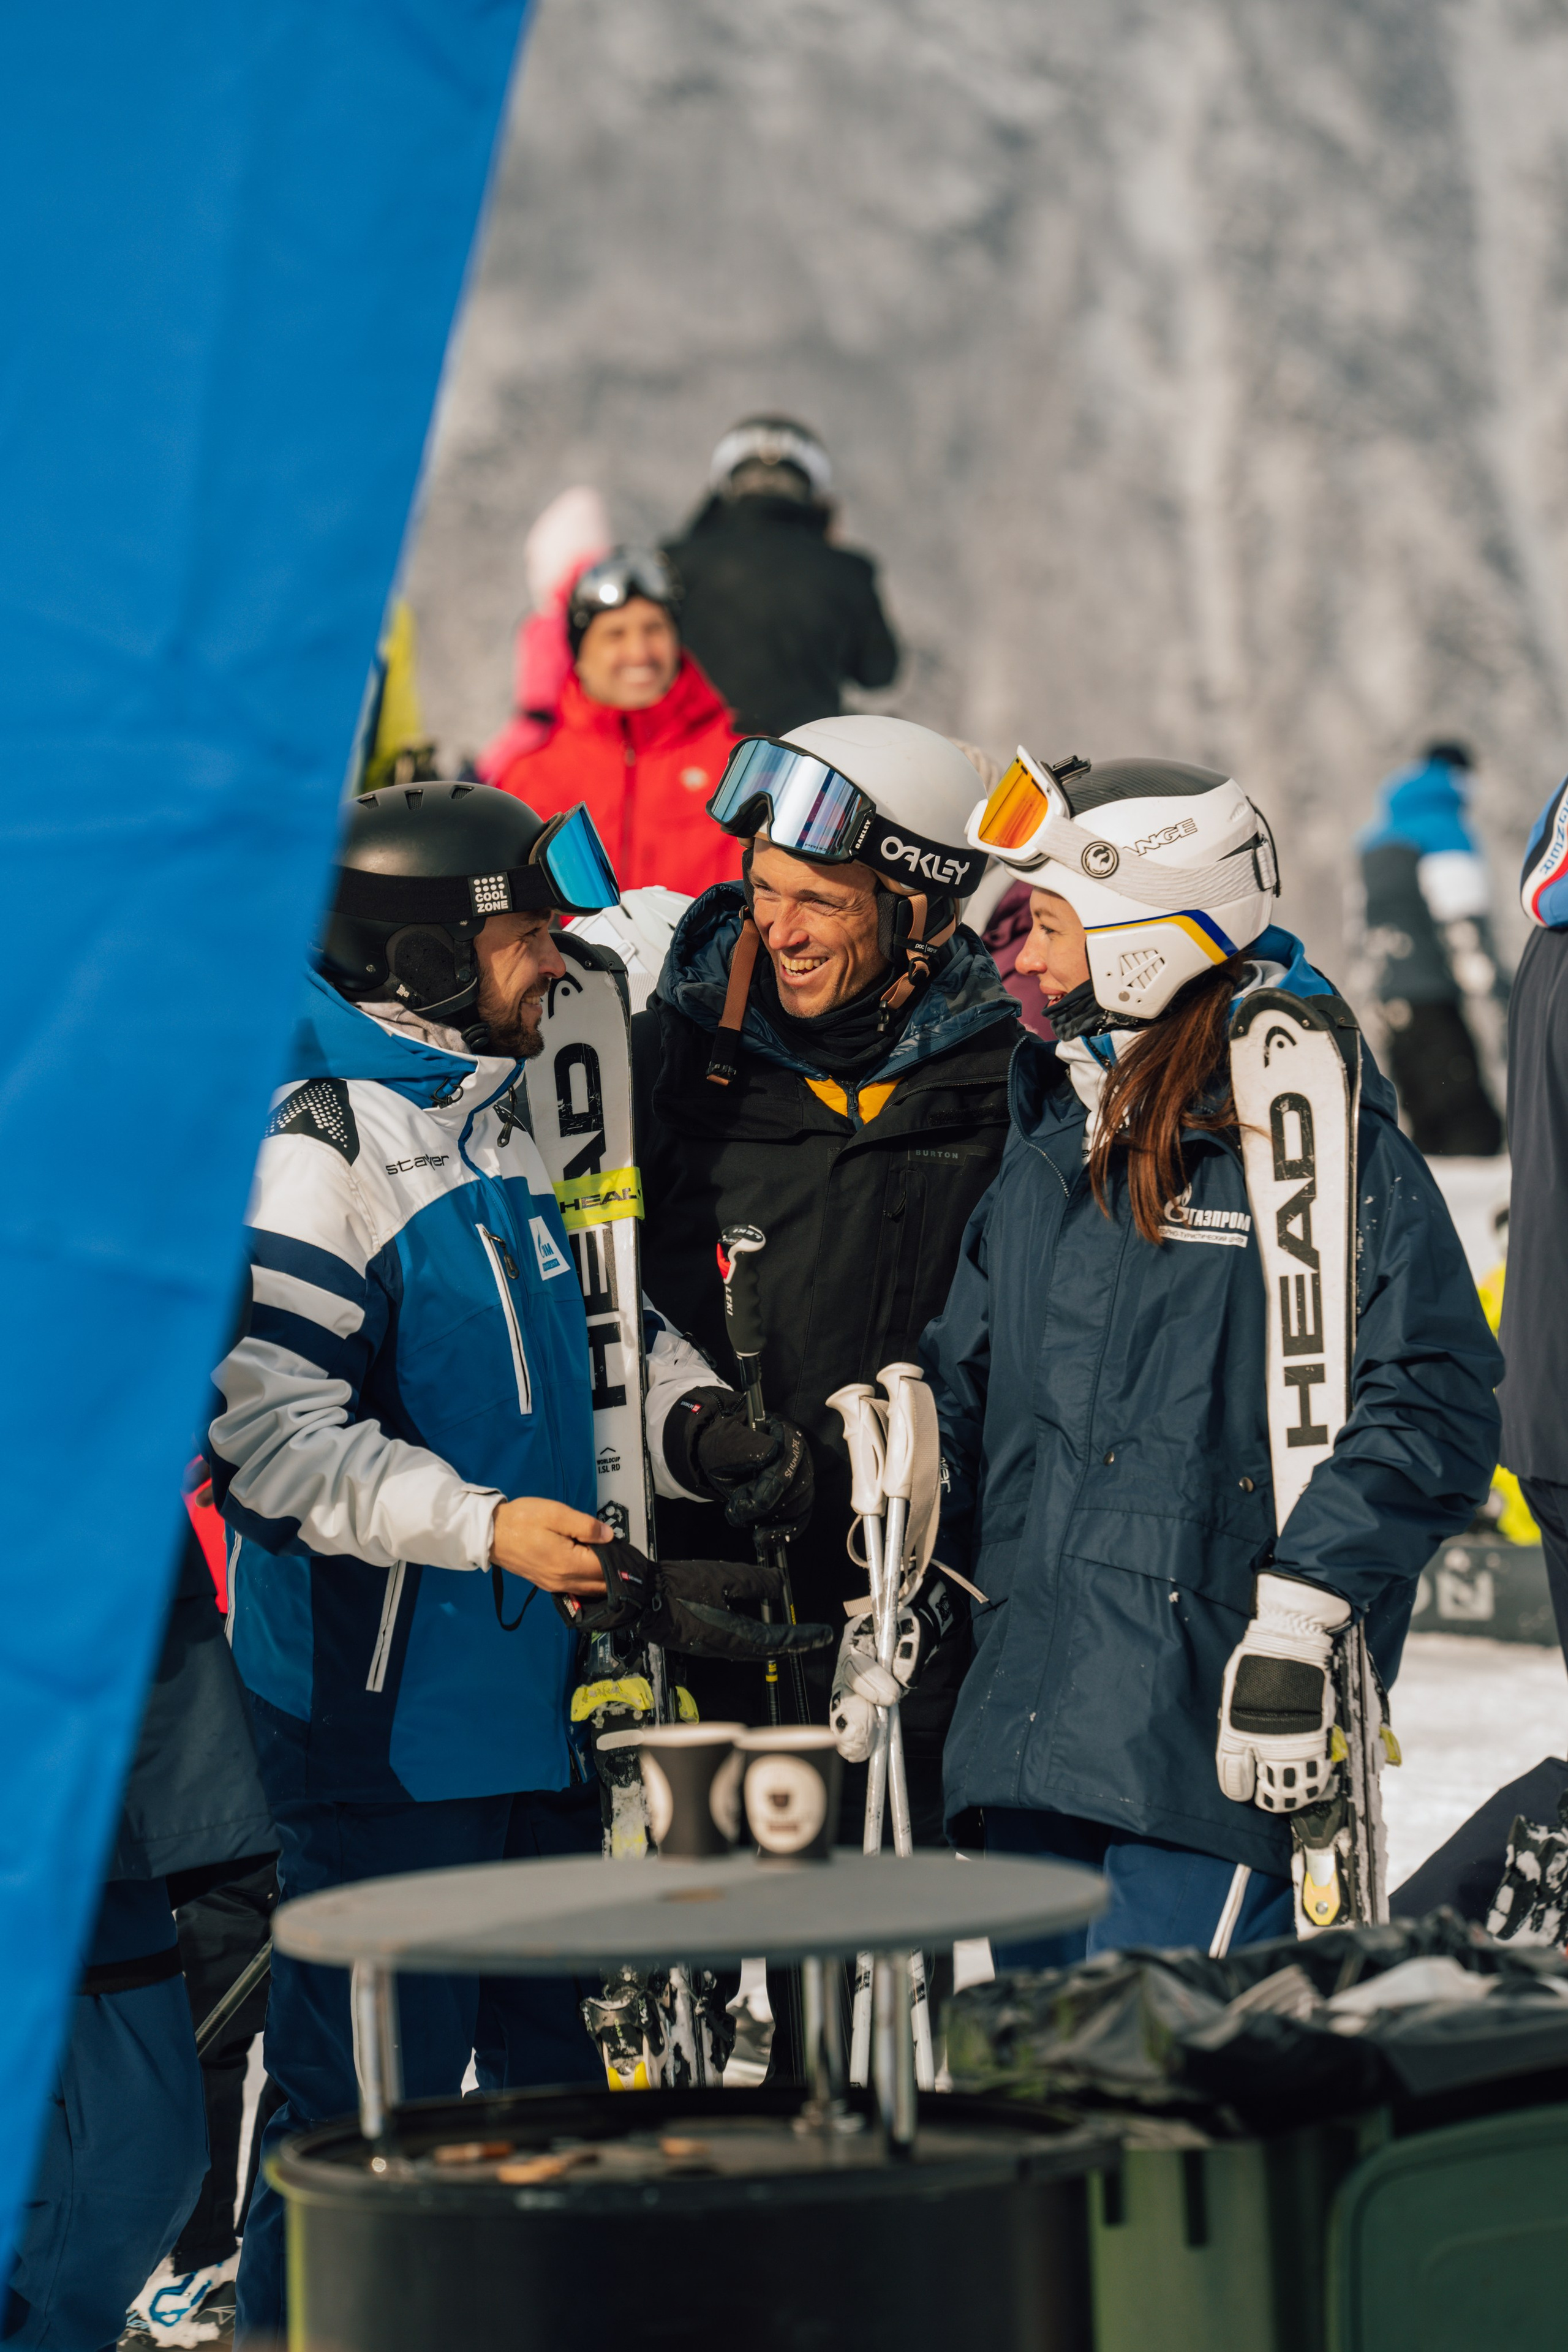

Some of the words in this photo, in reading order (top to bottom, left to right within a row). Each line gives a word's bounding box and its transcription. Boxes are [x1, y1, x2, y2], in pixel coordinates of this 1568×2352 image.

[855, 819, 871, 850] OAKLEY
[881, 836, 970, 885] OAKLEY
[475, 890, 507, 903] COOL
[477, 900, 509, 913] ZONE
[916, 1150, 958, 1159] BURTON
[385, 1154, 450, 1175] stayer
[1188, 1208, 1251, 1232] ГАЗПРОМ
[733, 1227, 762, 1240] LEKI
[1269, 1092, 1329, 1448] HEAD
[597, 1457, 620, 1465] WORLDCUP
